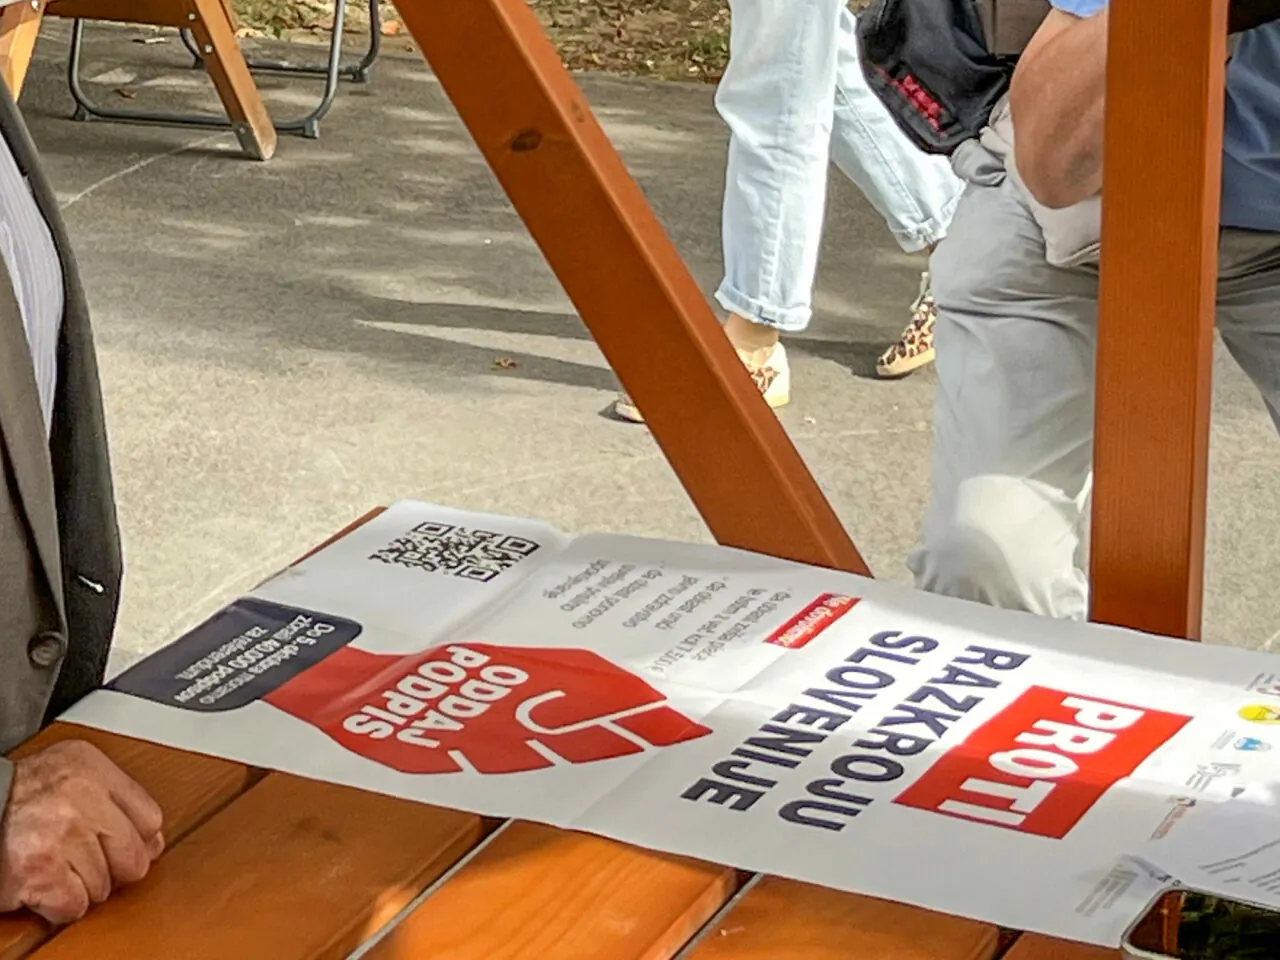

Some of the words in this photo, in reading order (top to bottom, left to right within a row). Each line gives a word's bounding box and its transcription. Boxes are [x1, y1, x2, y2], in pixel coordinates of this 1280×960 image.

[343, 645, 491, 739] PODPIS
[396, 665, 529, 748] ODDAJ
[680, 630, 939, 812] SLOVENIJE
[777, 644, 1031, 833] RAZKROJU
[936, 696, 1145, 826] PROTI
